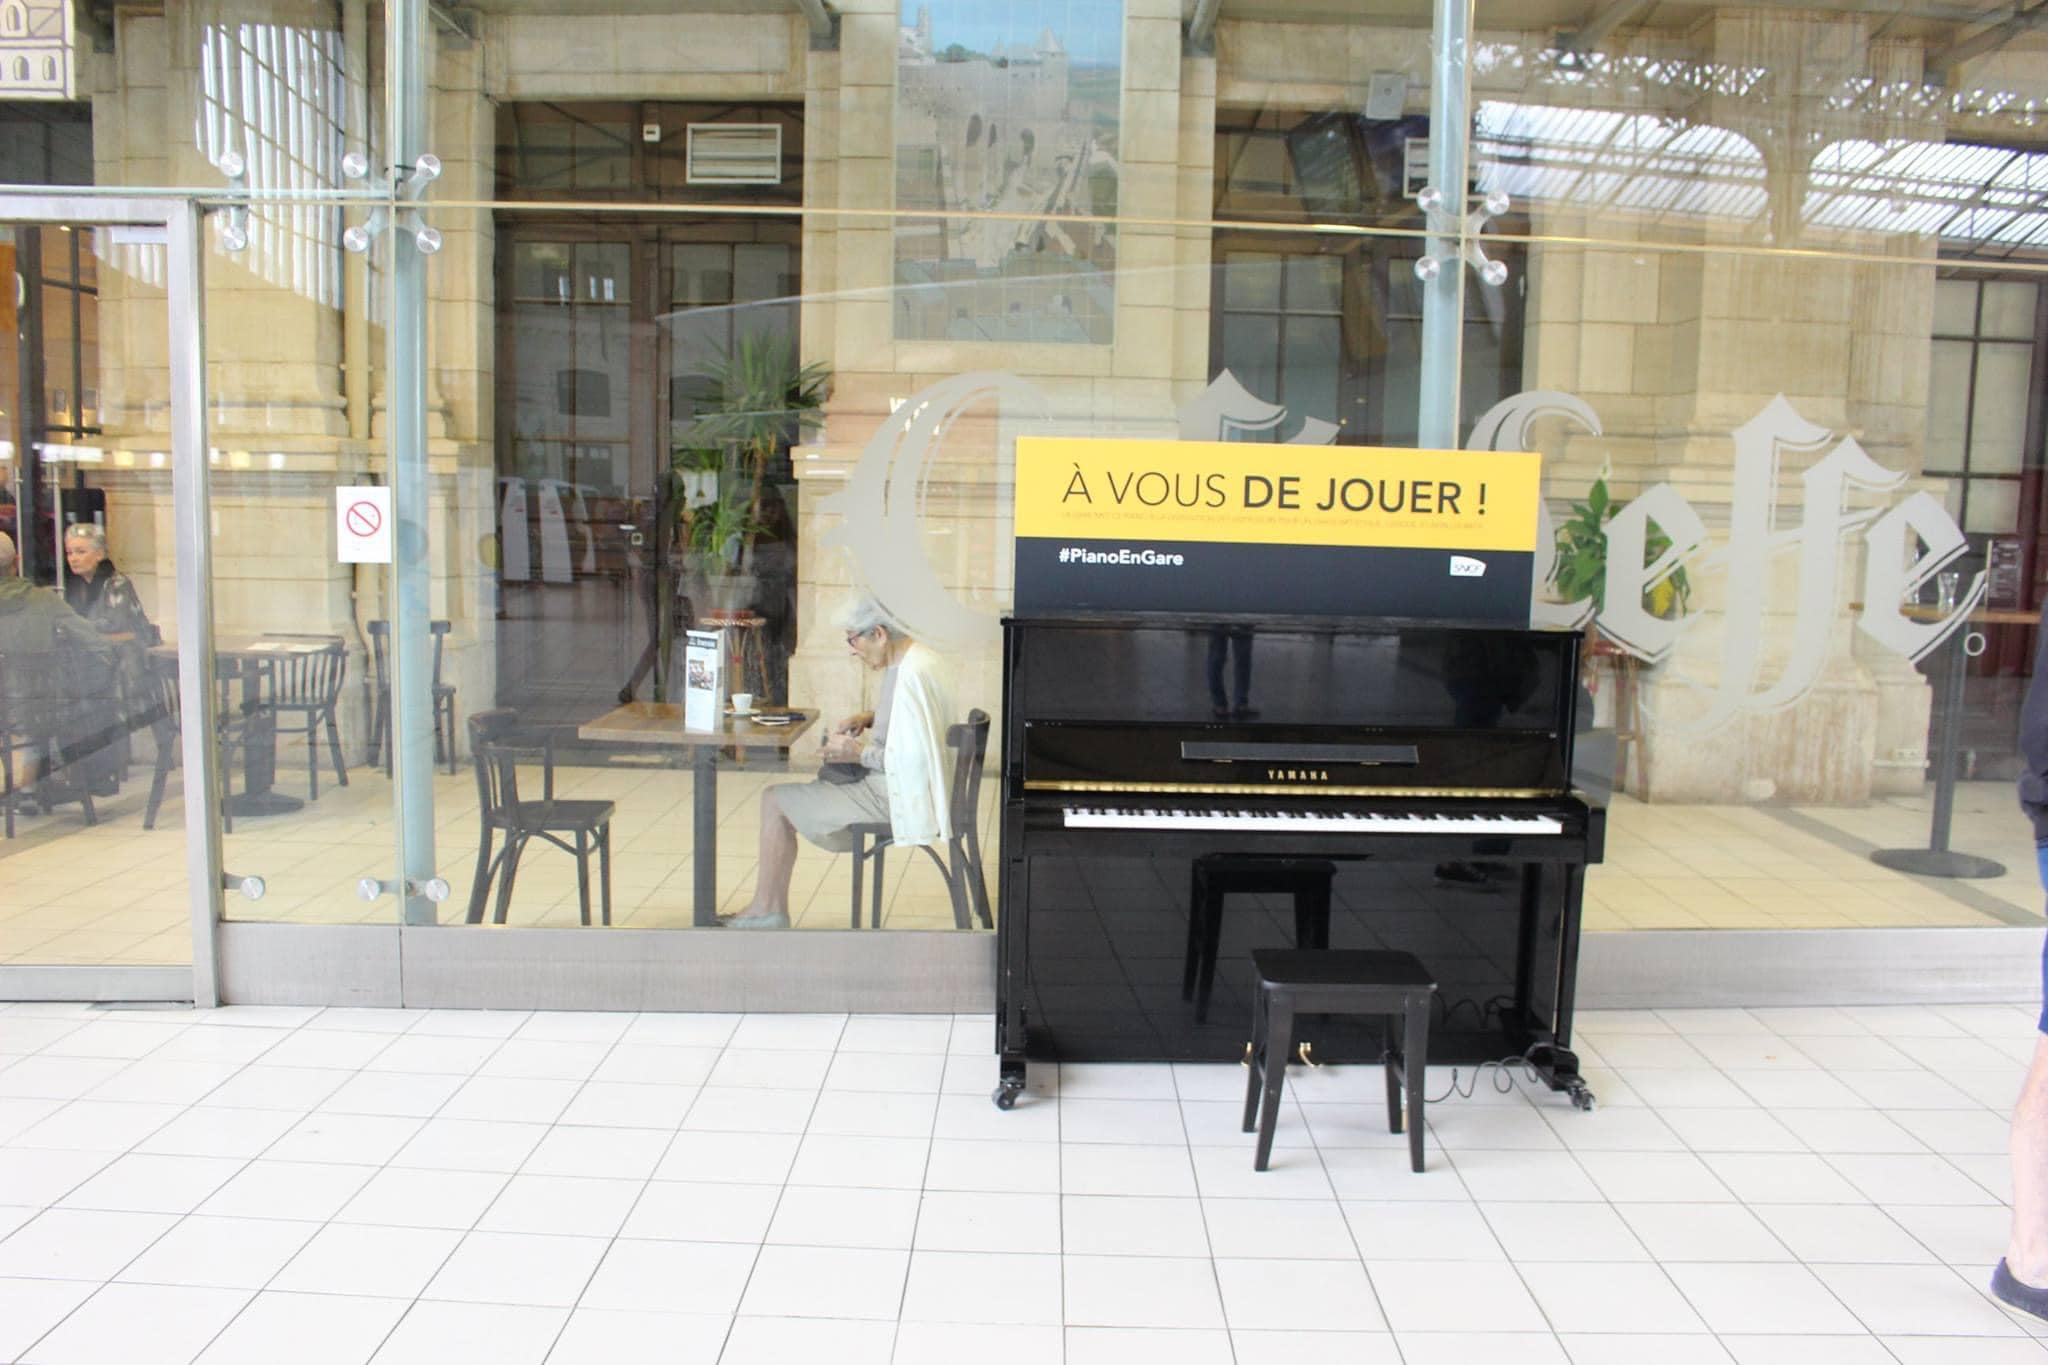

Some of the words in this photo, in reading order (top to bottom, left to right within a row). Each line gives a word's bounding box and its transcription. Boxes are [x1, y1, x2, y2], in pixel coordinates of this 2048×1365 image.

[1062, 463, 1092, 504] À
[1107, 471, 1226, 508] VOUS
[1243, 475, 1300, 510] DE
[1316, 477, 1462, 515] JOUER
[1478, 482, 1487, 516] !
[1059, 547, 1184, 566] #PianoEnGare
[1267, 769, 1329, 780] YAMAHA
